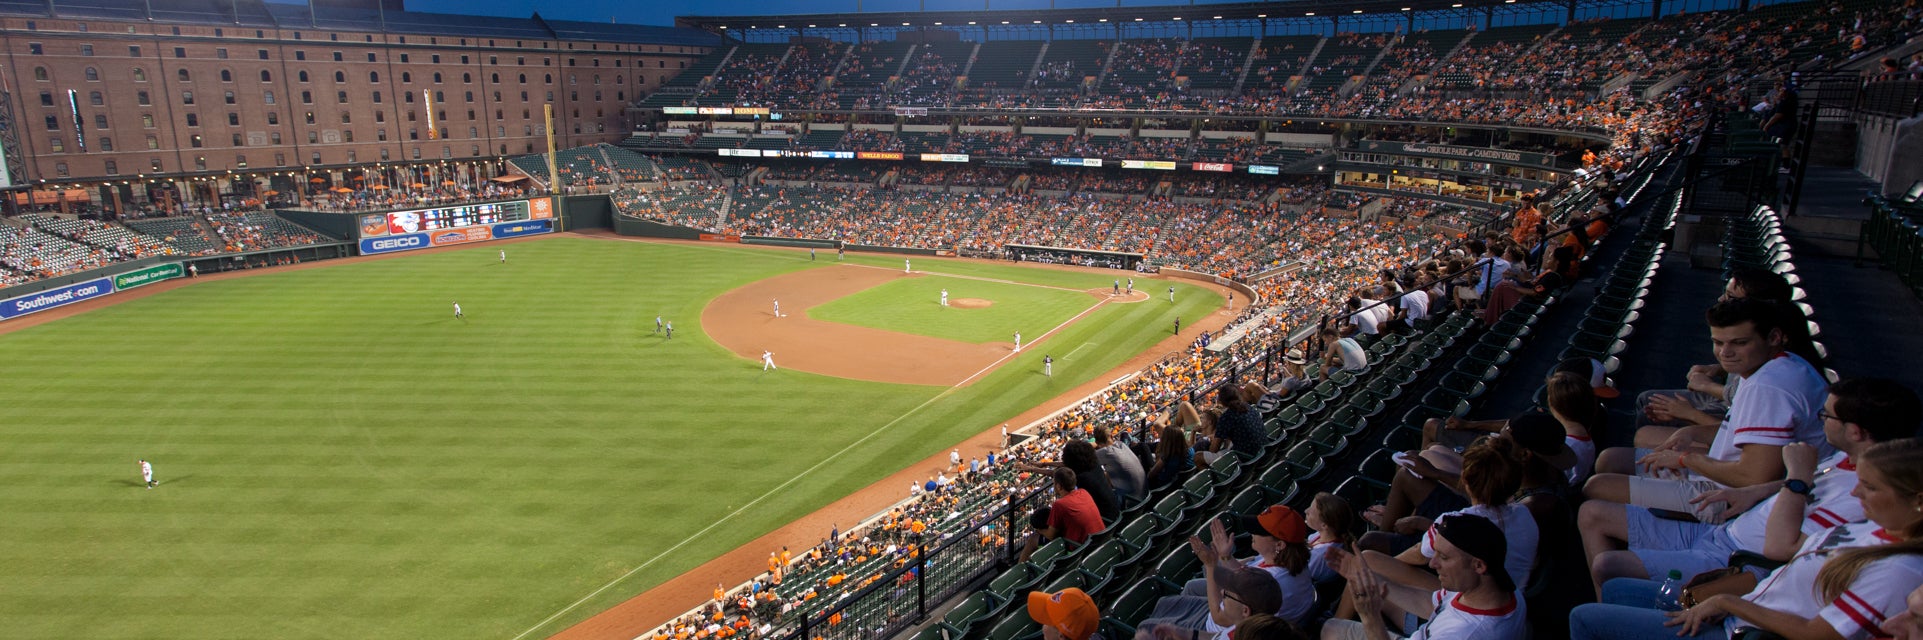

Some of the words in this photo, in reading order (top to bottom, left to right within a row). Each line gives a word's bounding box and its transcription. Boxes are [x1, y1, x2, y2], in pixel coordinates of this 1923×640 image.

[1426, 146, 1451, 154] ORIOLE
[1451, 147, 1468, 156] PARK
[1474, 149, 1501, 159] CAMDEN
[1501, 152, 1521, 161] YARDS
[372, 236, 420, 250] GEICO
[126, 273, 149, 284] National
